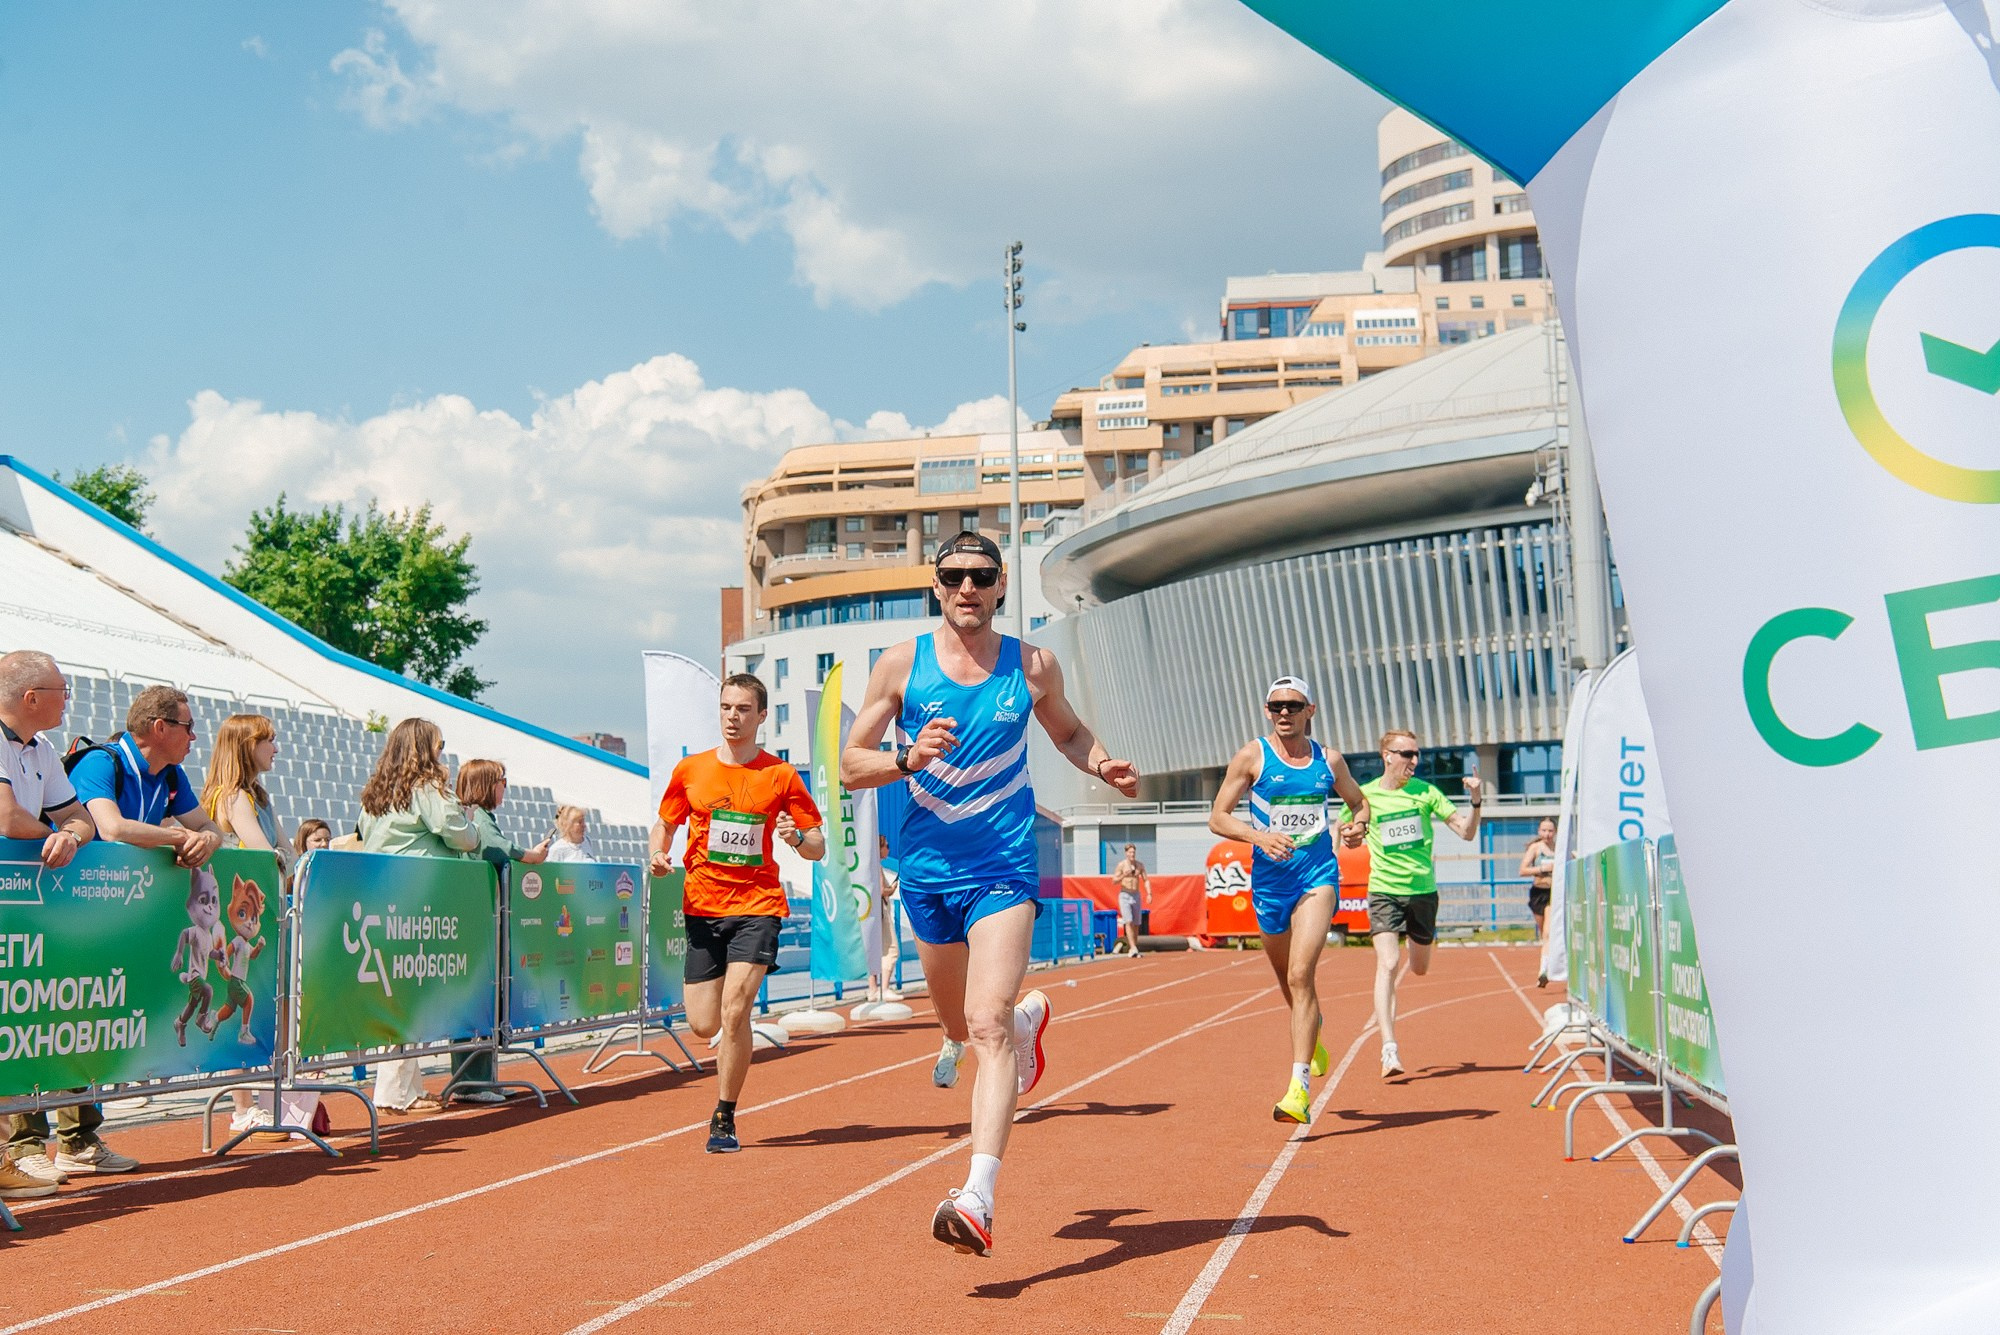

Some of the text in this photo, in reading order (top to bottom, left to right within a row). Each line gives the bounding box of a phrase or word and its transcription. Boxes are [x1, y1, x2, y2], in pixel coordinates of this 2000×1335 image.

[1282, 813, 1316, 826] 0263
[1389, 824, 1416, 837] 0258
[721, 831, 755, 846] 0266
[80, 865, 129, 881] зелёный
[72, 884, 125, 900] марафон
[0, 1009, 146, 1061] ОХНОВЛЯЙ
